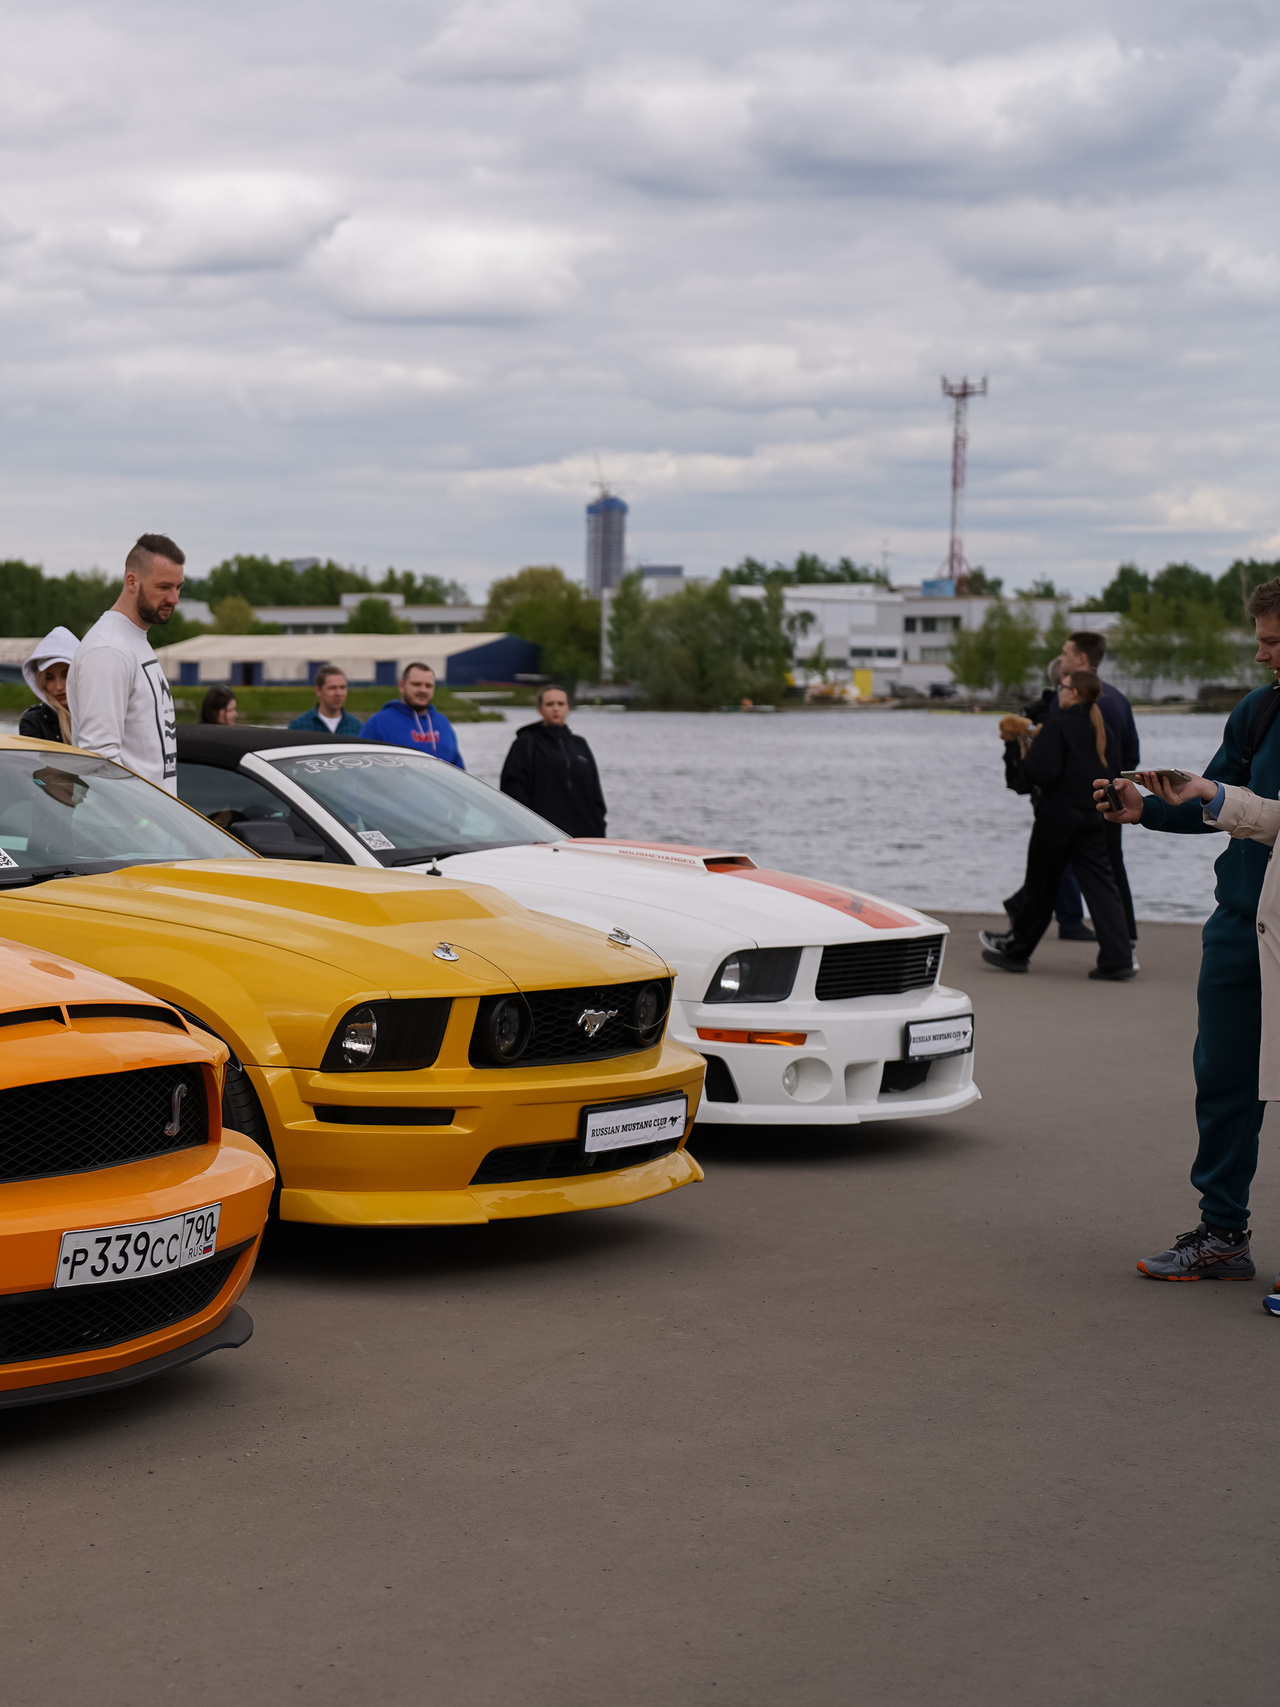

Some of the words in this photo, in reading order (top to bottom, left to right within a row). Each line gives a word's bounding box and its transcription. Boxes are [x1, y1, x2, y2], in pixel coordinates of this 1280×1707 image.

[618, 849, 696, 865] ROUSHCHARGED
[591, 1125, 621, 1138] RUSSIAN
[621, 1120, 653, 1133] MUSTANG
[653, 1117, 668, 1127] CLUB
[185, 1211, 215, 1249] 790
[187, 1244, 203, 1259] RUS
